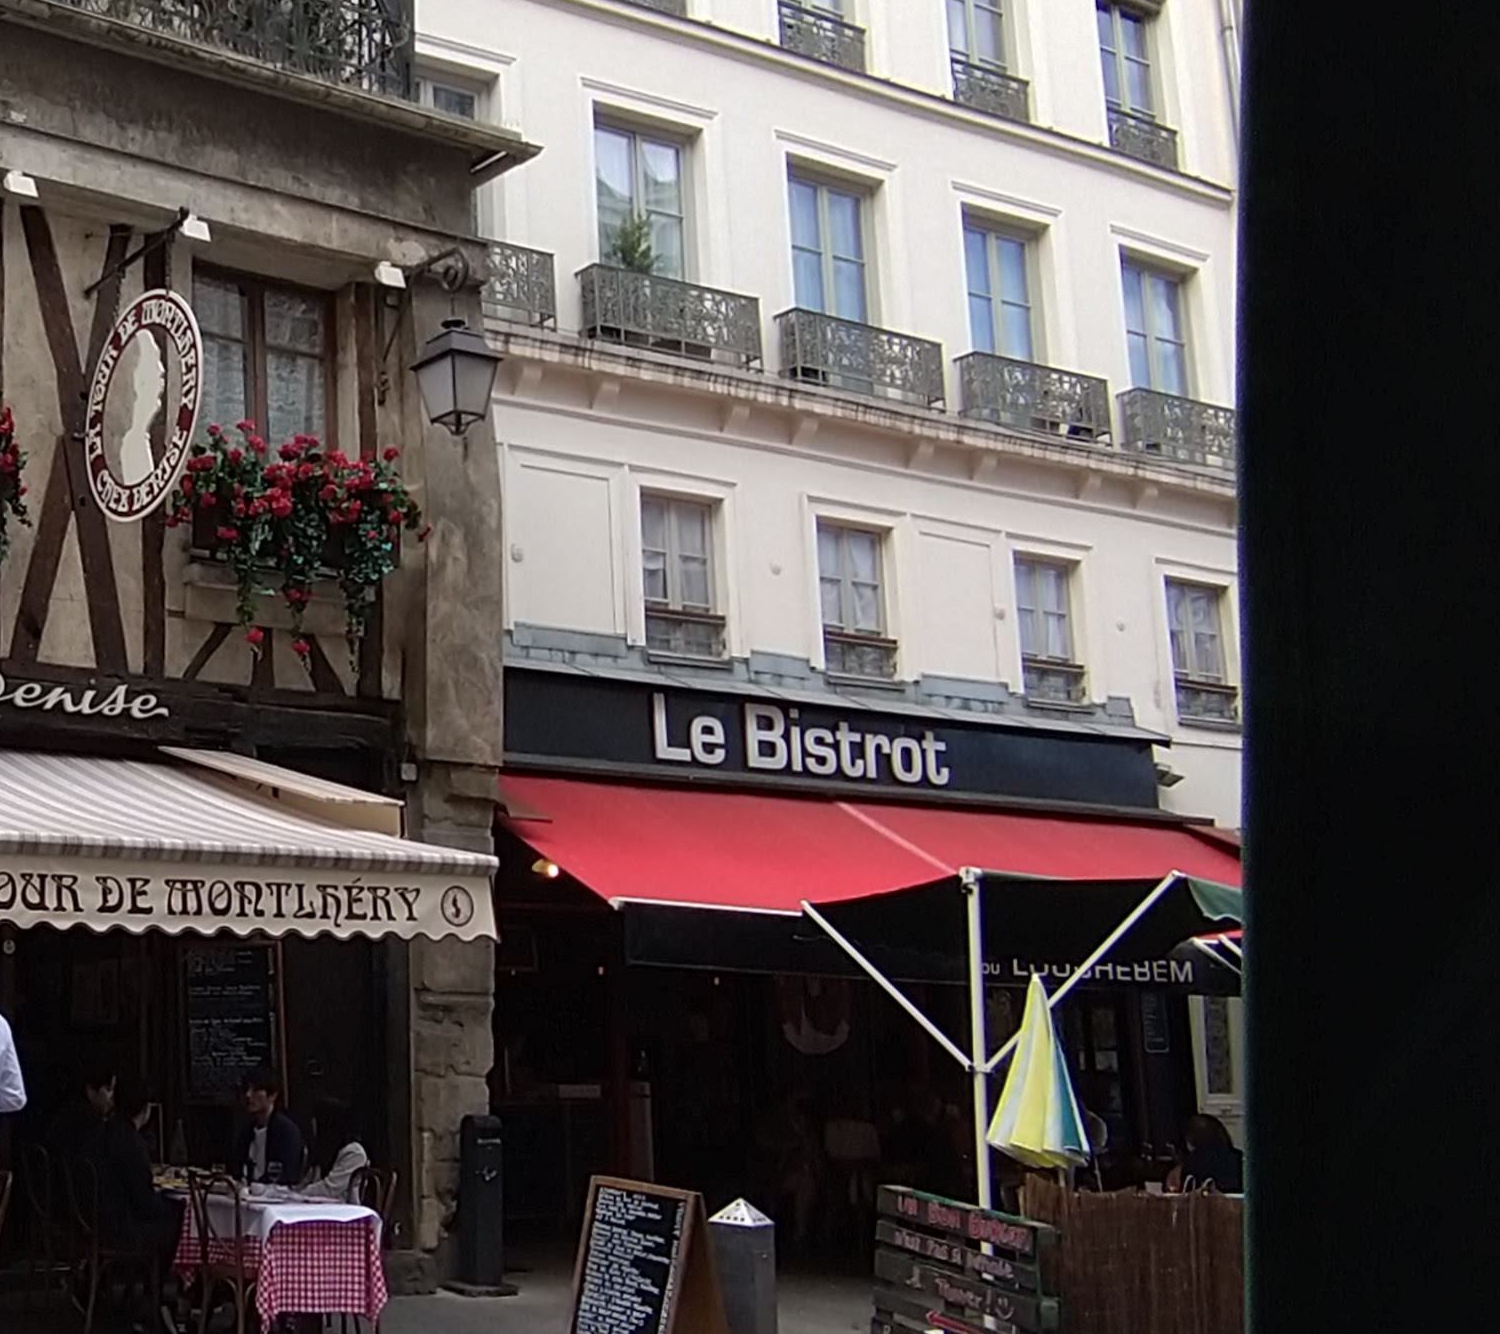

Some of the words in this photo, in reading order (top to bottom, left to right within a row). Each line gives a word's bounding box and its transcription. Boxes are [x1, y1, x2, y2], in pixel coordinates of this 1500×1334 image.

[90, 344, 120, 419] TOUR
[117, 308, 140, 347] DE
[652, 691, 726, 765] Le
[743, 701, 951, 787] Bistrot
[95, 875, 154, 915] DE
[163, 876, 422, 928] MONTLHÉRY
